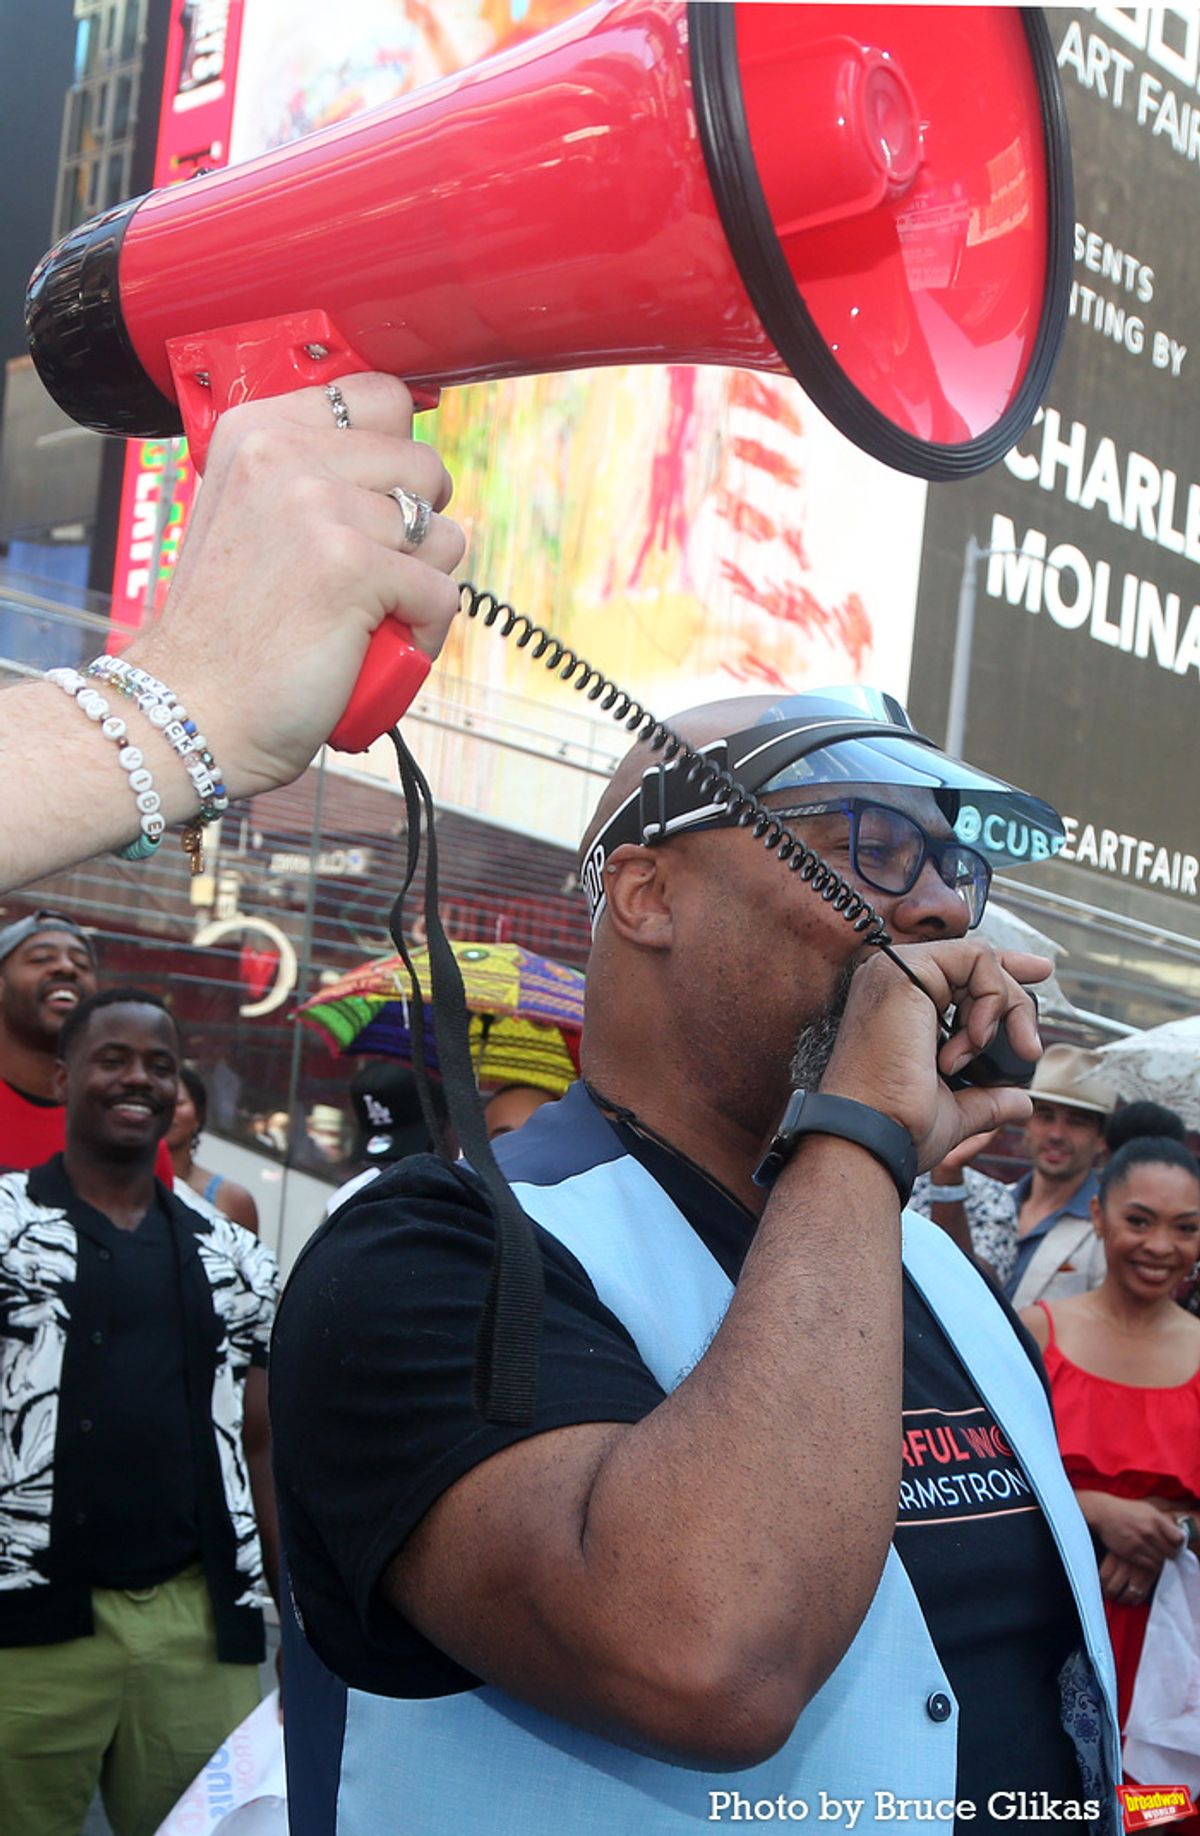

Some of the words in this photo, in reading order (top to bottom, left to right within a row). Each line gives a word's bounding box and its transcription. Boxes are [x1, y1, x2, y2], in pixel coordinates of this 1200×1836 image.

[1057, 20, 1134, 108] ART
[1152, 331, 1188, 377] BY
[986, 513, 1200, 682] MOLINA
[123, 749, 164, 833] VIBE
[363, 1094, 393, 1125] LA
[899, 1468, 1031, 1510] RMSTRON
